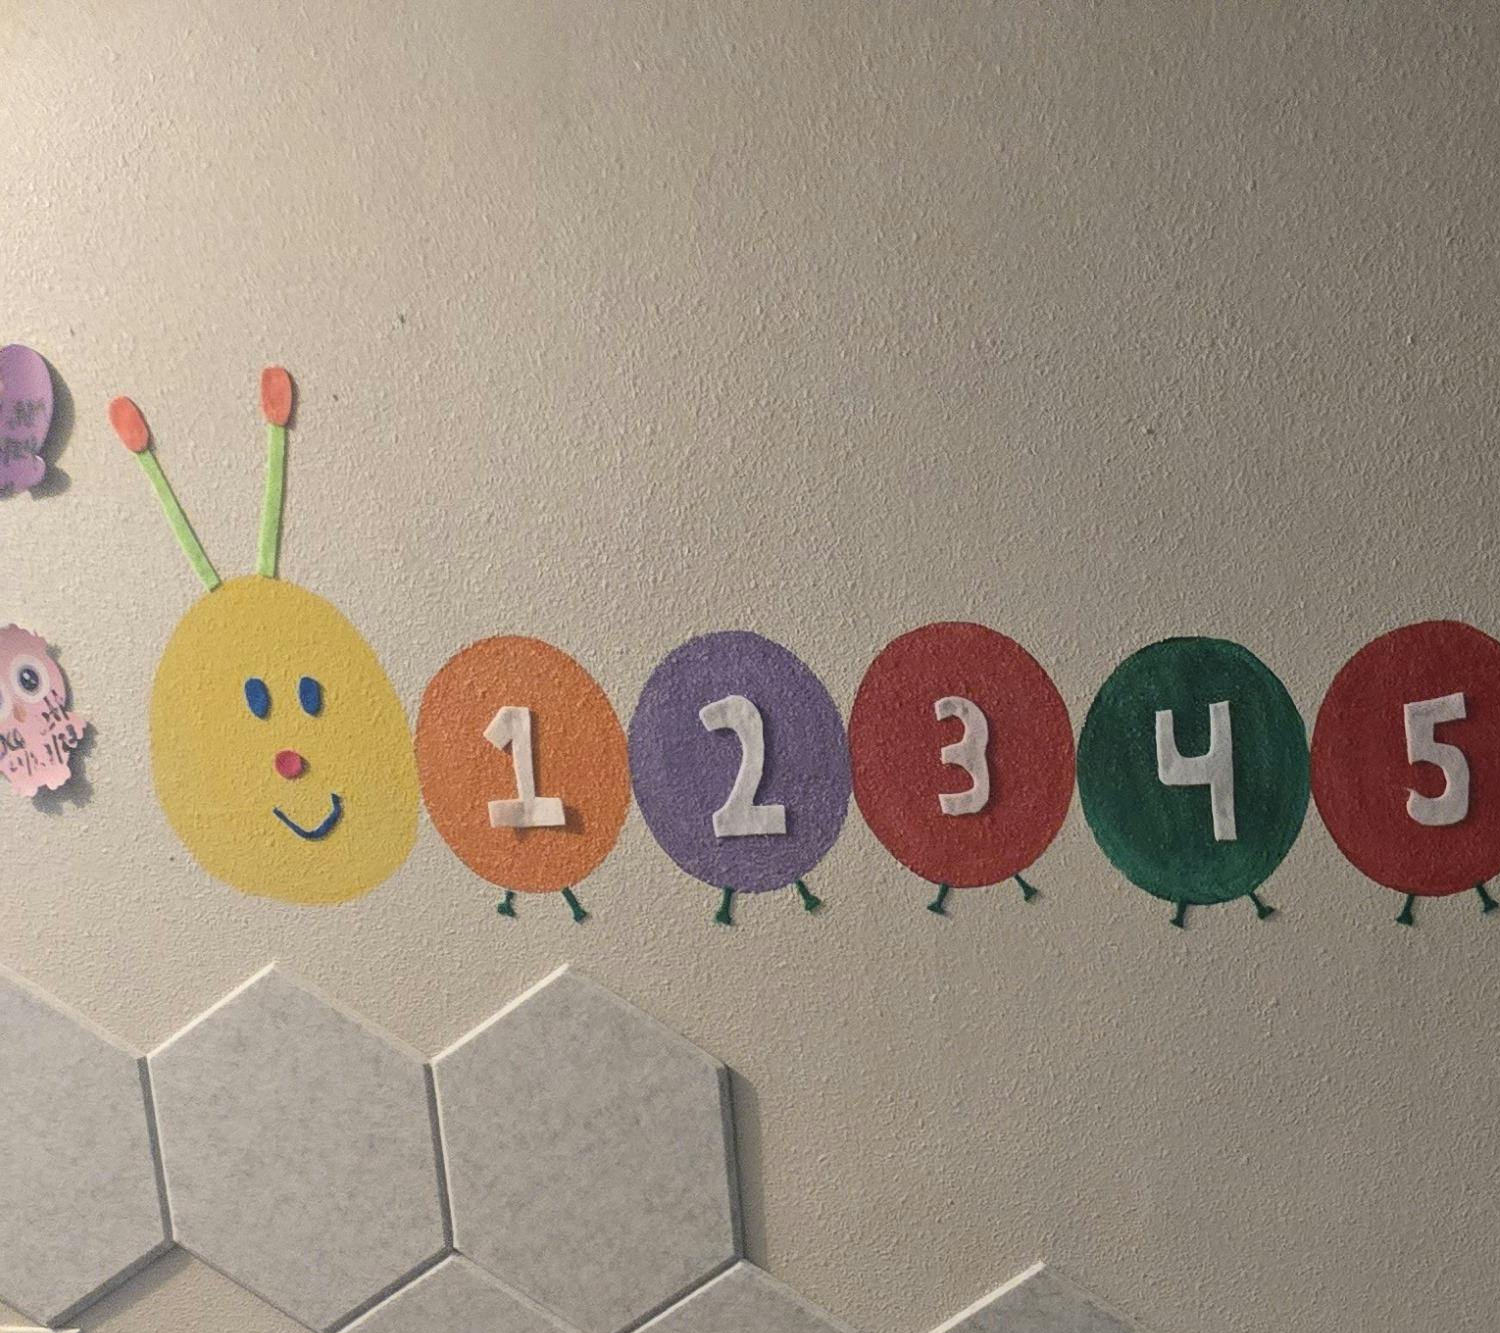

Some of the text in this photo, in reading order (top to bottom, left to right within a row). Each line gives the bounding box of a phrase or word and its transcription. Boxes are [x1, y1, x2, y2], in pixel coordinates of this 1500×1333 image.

[483, 705, 566, 828] 1
[699, 694, 786, 838] 2
[934, 695, 990, 816] 3
[1155, 701, 1238, 841] 4
[1403, 691, 1469, 827] 5
